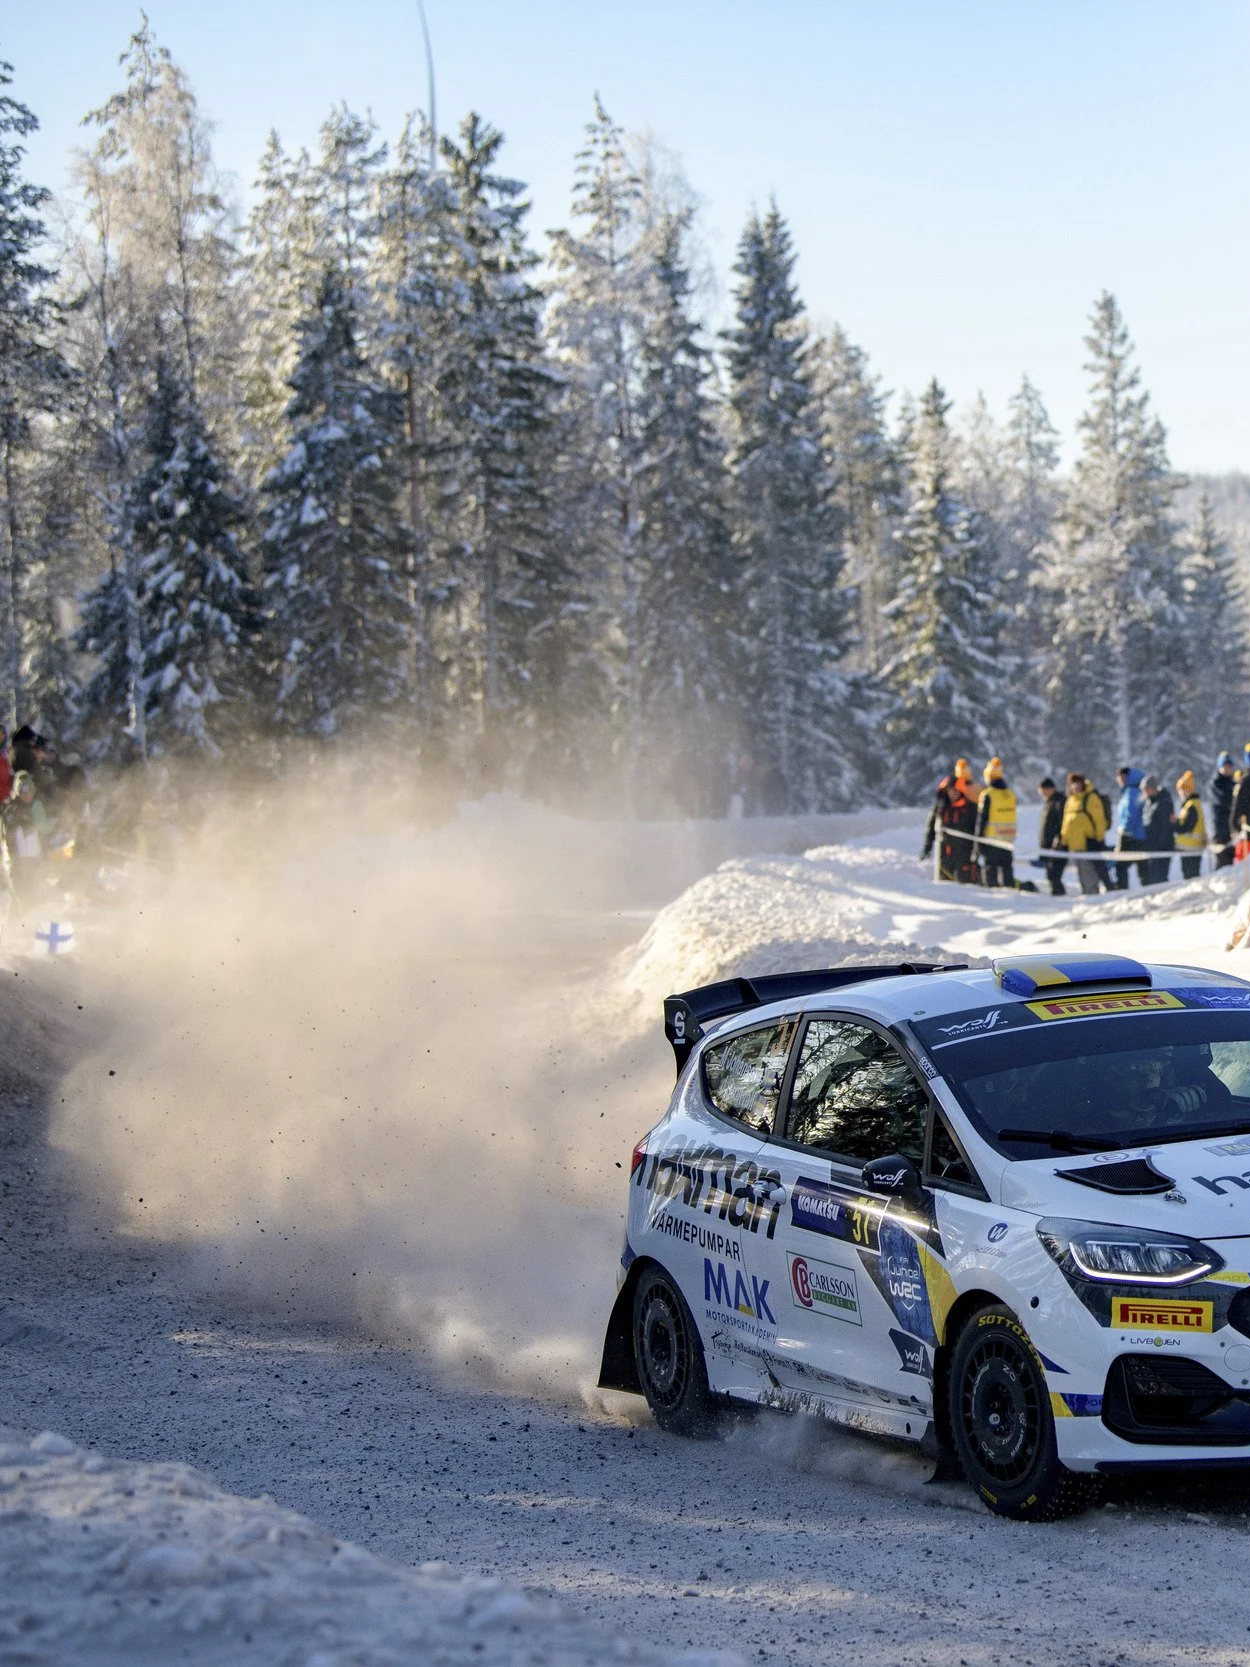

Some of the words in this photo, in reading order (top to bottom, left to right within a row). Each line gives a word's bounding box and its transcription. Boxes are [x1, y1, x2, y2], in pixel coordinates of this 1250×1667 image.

[1043, 994, 1167, 1016] PIRELLI
[797, 1193, 840, 1221] KOMATSU
[651, 1208, 741, 1262] VÄRMEPUMPAR
[704, 1257, 777, 1325] MAK
[809, 1272, 855, 1299] CARLSSON
[889, 1280, 922, 1301] WRC
[1120, 1303, 1204, 1327] PIRELLI
